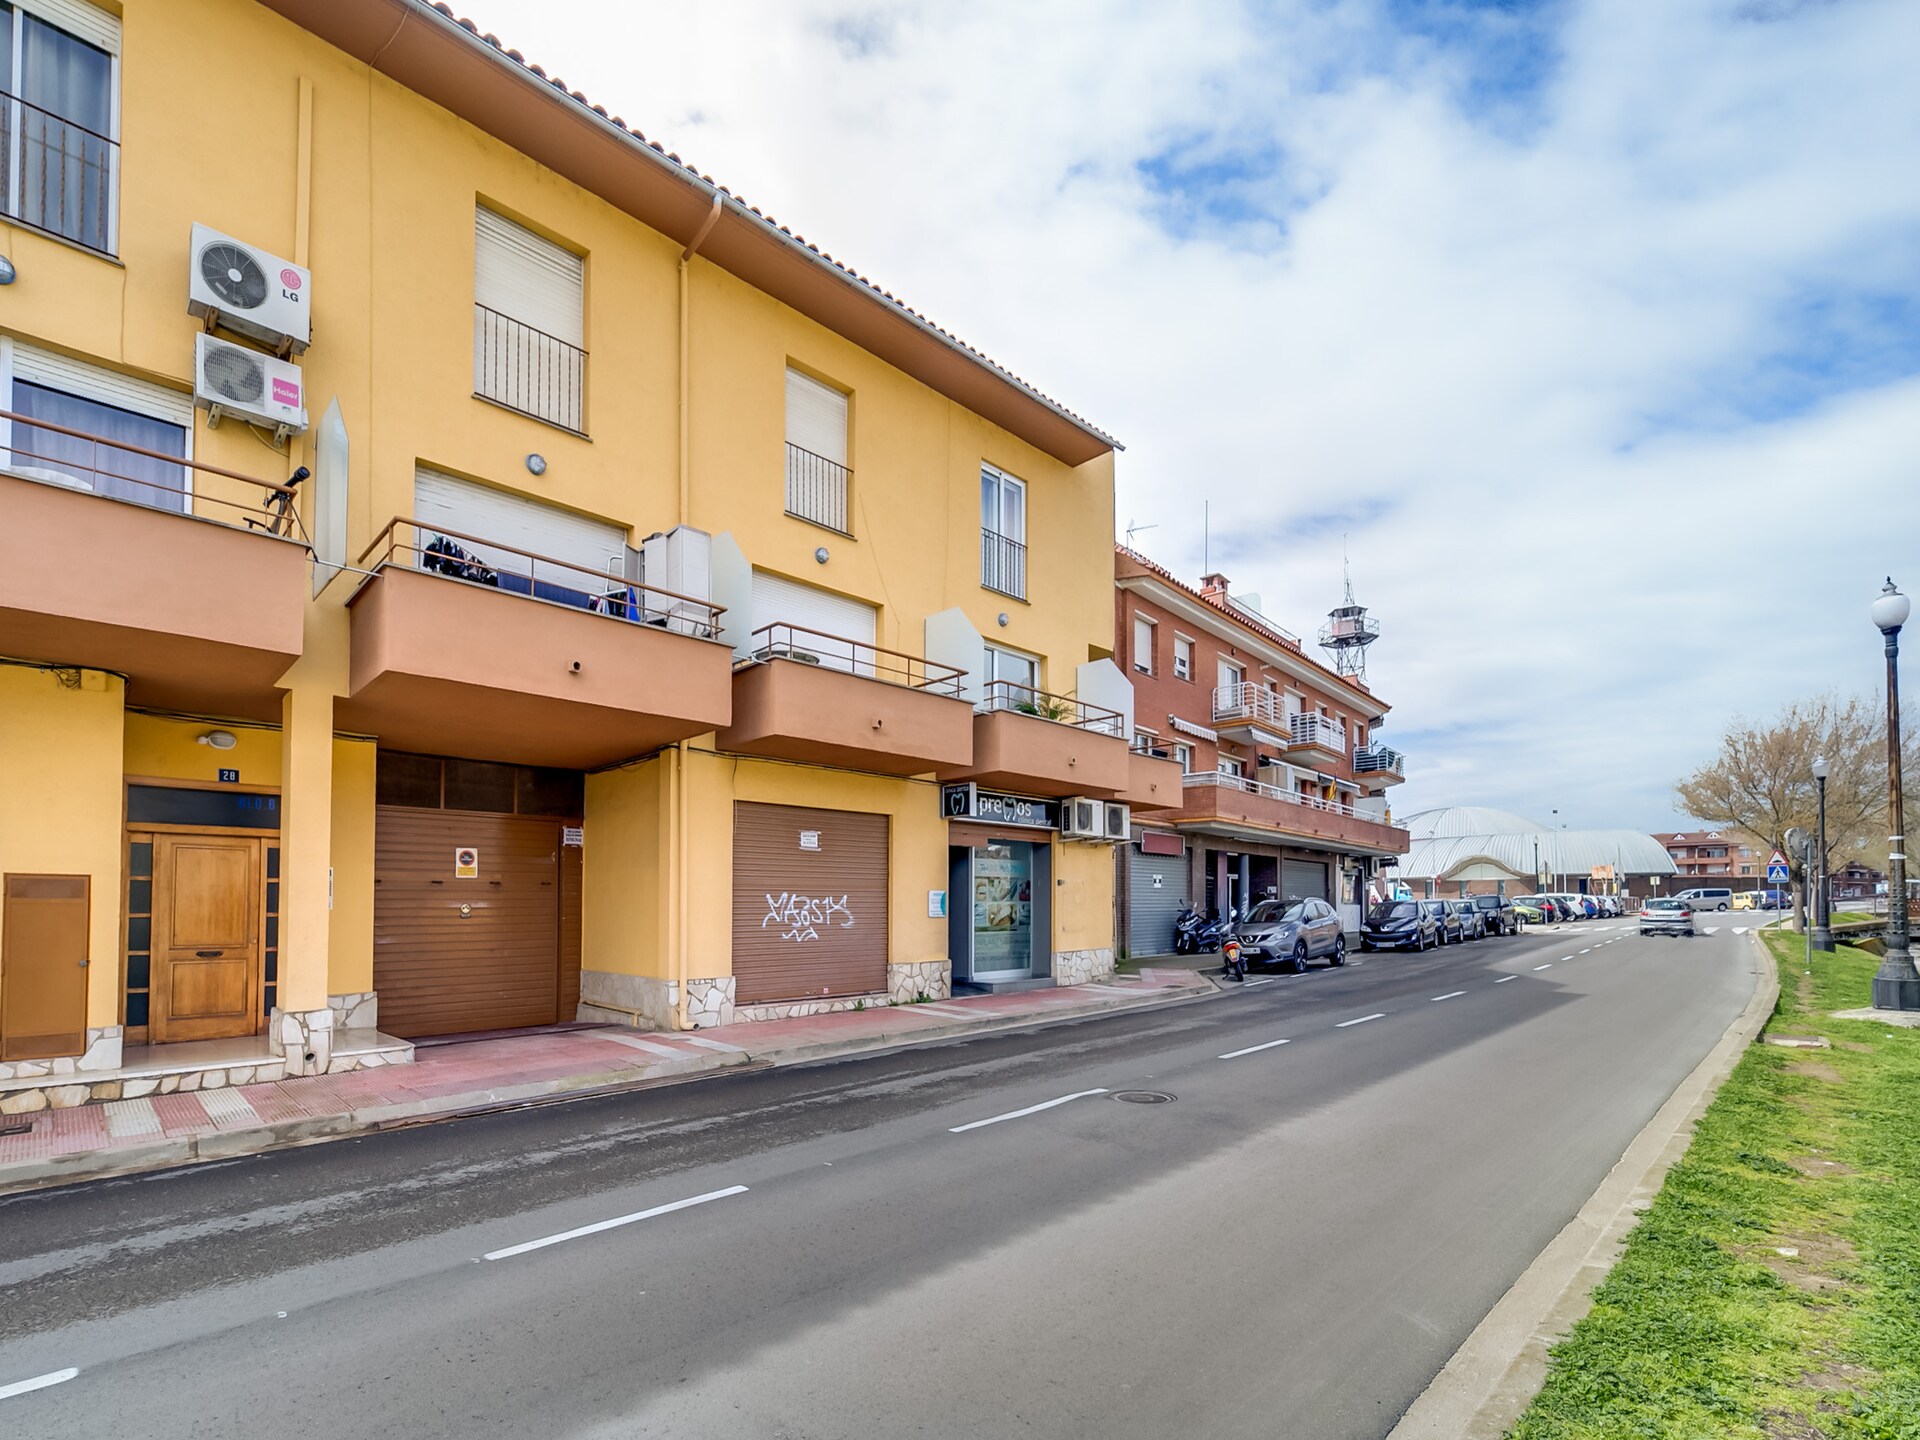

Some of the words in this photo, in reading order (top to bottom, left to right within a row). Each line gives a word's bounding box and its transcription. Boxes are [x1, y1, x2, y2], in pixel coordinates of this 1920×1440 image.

[282, 288, 299, 303] LG
[273, 385, 298, 400] Haier
[223, 770, 236, 781] 28
